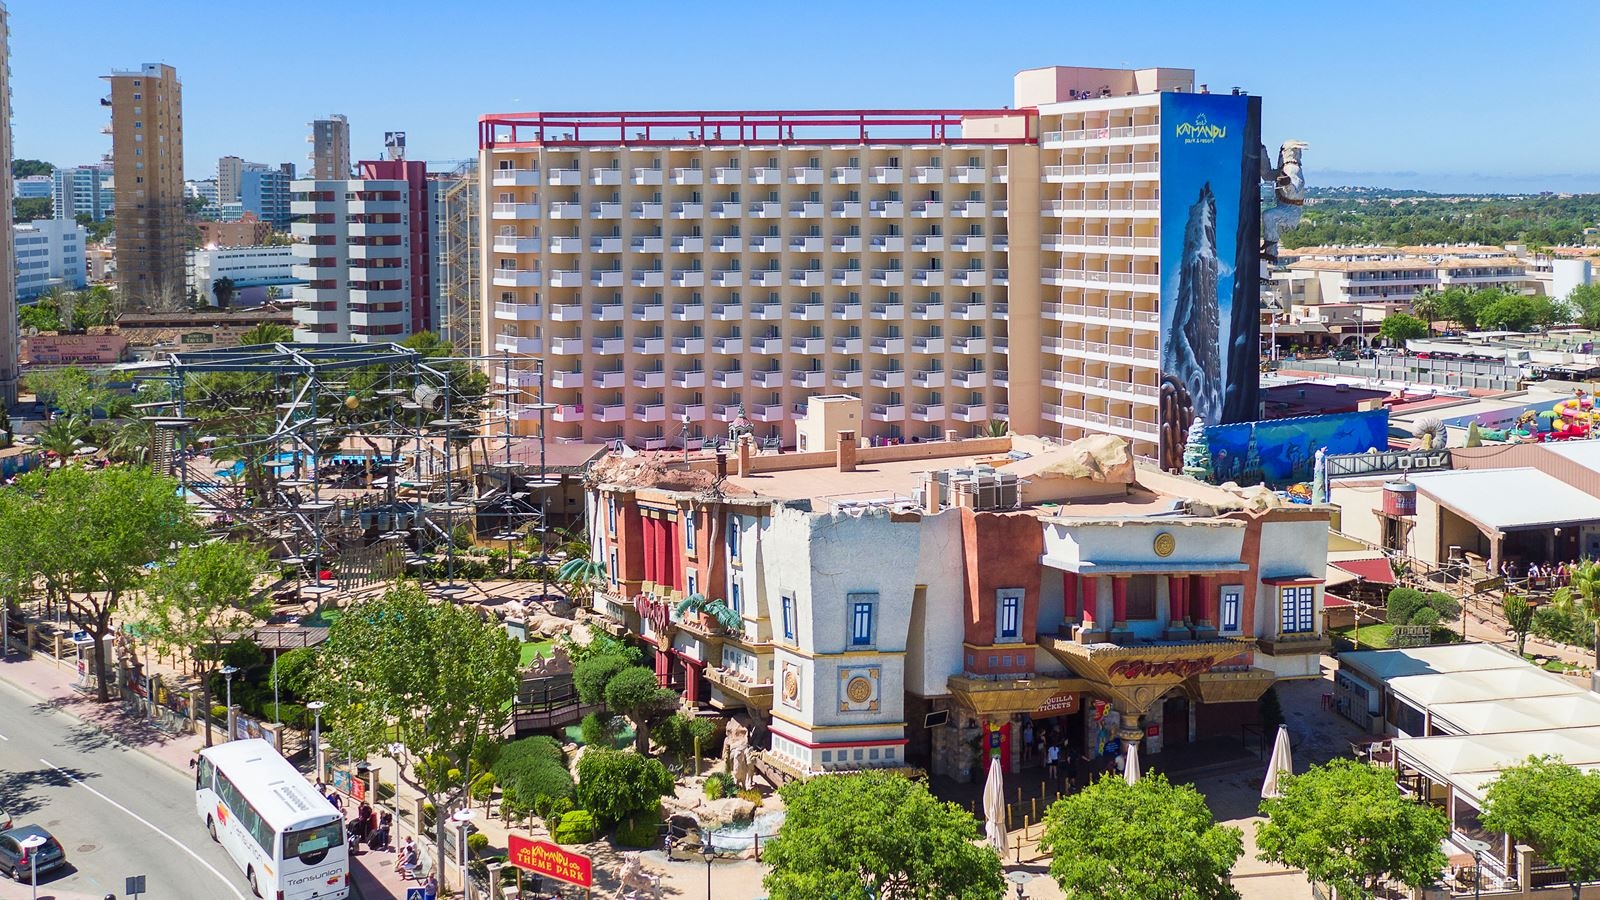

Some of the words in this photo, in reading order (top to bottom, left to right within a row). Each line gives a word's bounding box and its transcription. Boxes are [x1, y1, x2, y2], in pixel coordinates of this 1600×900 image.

[1176, 122, 1226, 139] KATMANDU
[1039, 701, 1071, 711] TICKETS
[1044, 694, 1073, 705] QUILLA
[531, 845, 569, 867] KATMANDU
[516, 852, 552, 871] THEME
[556, 864, 585, 881] PARK
[287, 867, 343, 886] Transunion
